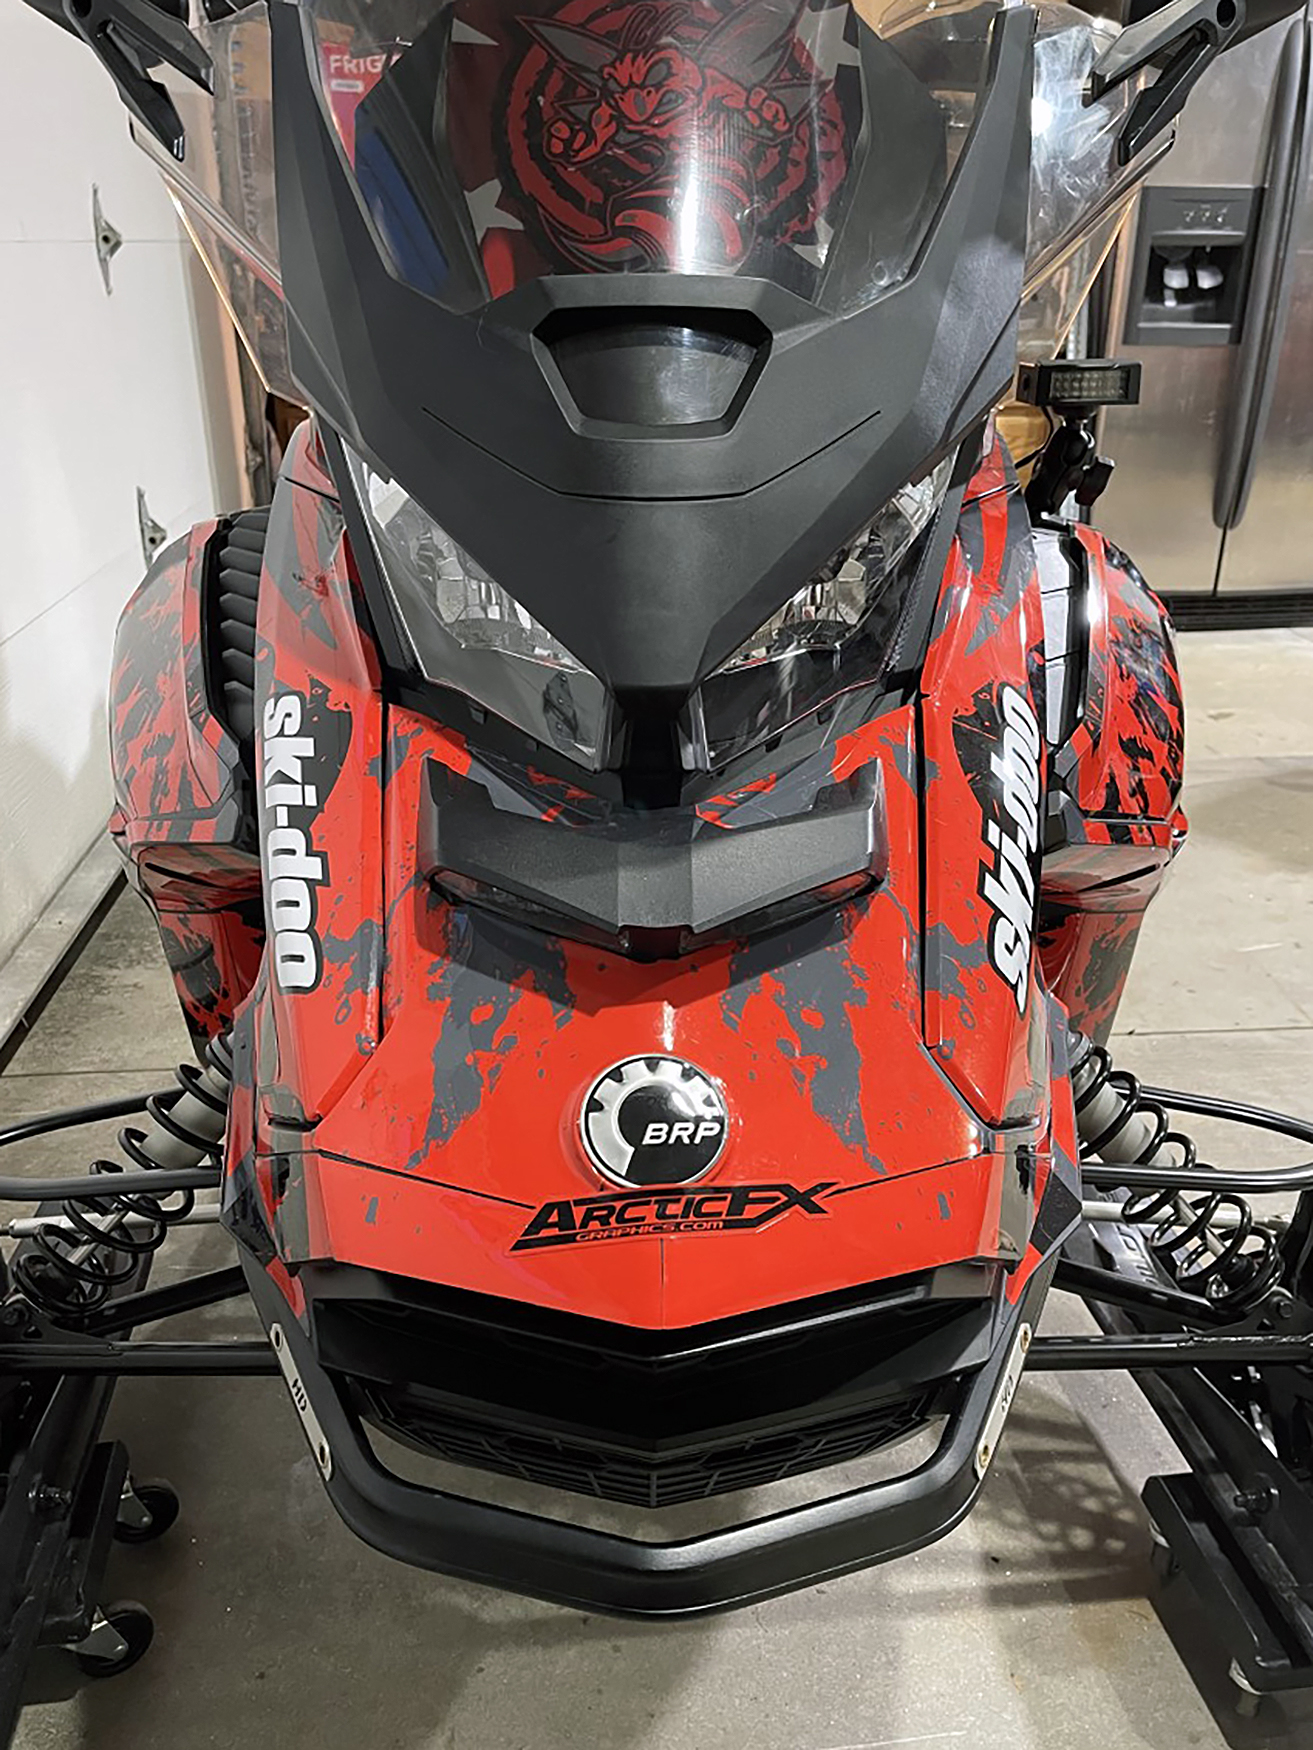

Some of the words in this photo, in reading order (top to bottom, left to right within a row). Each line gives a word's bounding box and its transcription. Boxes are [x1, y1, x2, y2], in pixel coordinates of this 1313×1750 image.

[264, 695, 323, 989] ski-doo
[984, 685, 1040, 1014] ski-doo
[641, 1121, 721, 1145] BRP
[575, 1219, 724, 1242] GRAPHICS.COM
